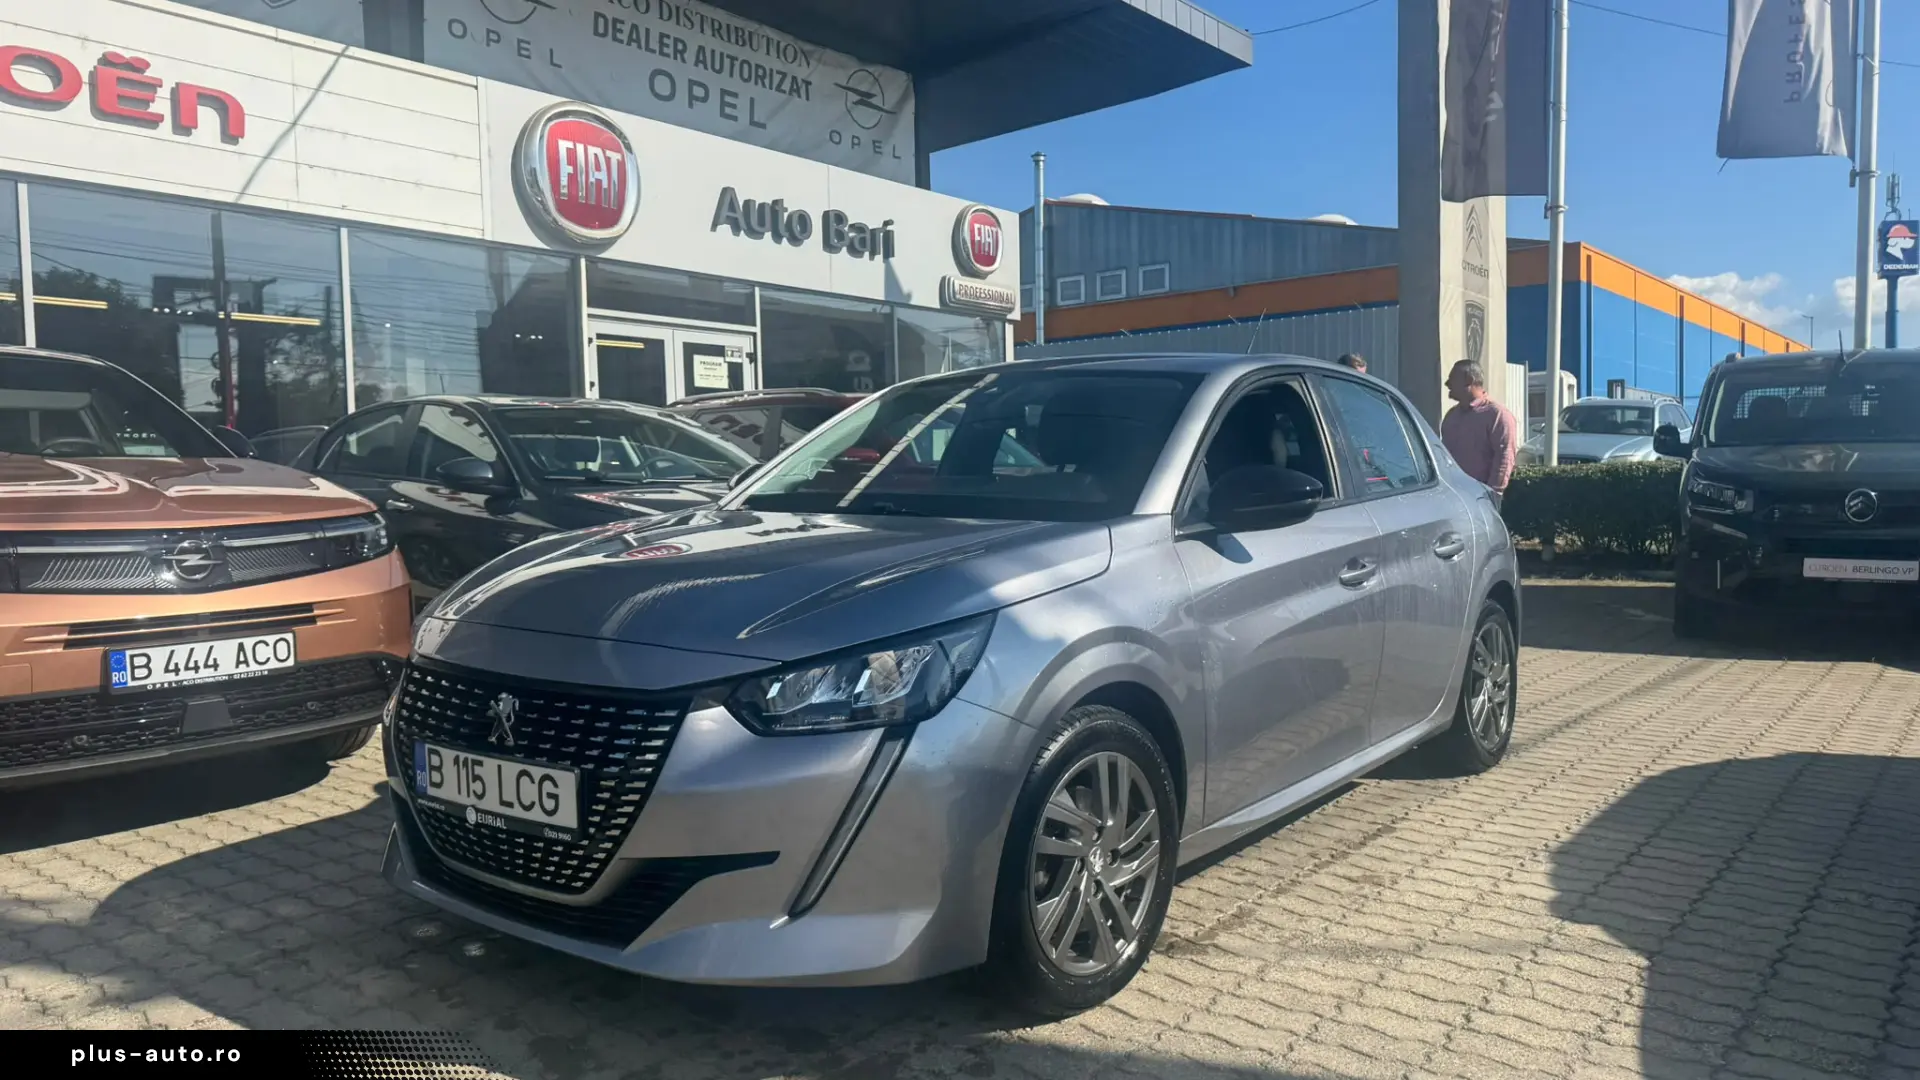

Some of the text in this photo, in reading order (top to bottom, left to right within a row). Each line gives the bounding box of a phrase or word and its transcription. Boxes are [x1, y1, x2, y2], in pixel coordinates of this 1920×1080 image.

[447, 18, 563, 68] OPEL
[593, 11, 812, 101] DEALER AUTORIZAT
[658, 0, 811, 68] DISTRIBUTION
[649, 68, 767, 130] OPEL
[829, 129, 902, 160] OPEL
[558, 138, 622, 209] FIAT
[710, 186, 895, 262] Auto Bari
[974, 223, 998, 256] FIAT
[958, 284, 1014, 304] PROFESSIONAL
[1852, 566, 1900, 574] BERLINGO
[112, 637, 292, 683] RO B 444 ACO
[416, 749, 560, 817] RO B 115 LCG
